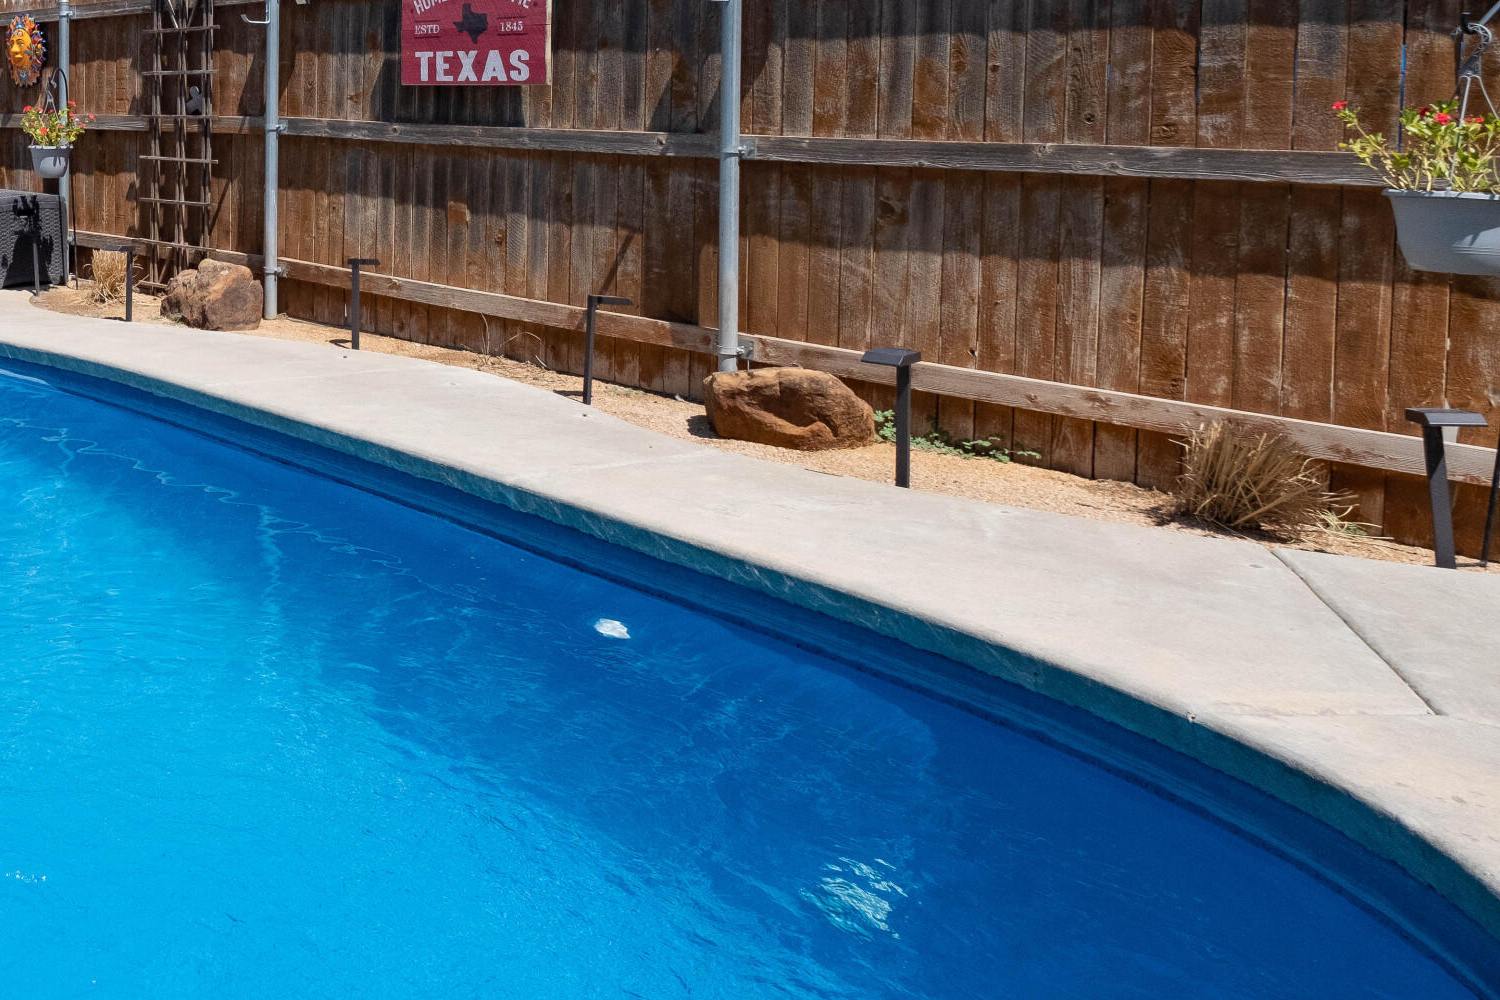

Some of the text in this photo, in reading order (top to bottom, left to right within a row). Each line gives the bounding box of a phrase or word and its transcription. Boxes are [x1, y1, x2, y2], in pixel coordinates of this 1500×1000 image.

[414, 24, 439, 34] ESTD
[500, 20, 523, 31] 1845
[414, 49, 530, 82] TEXAS
